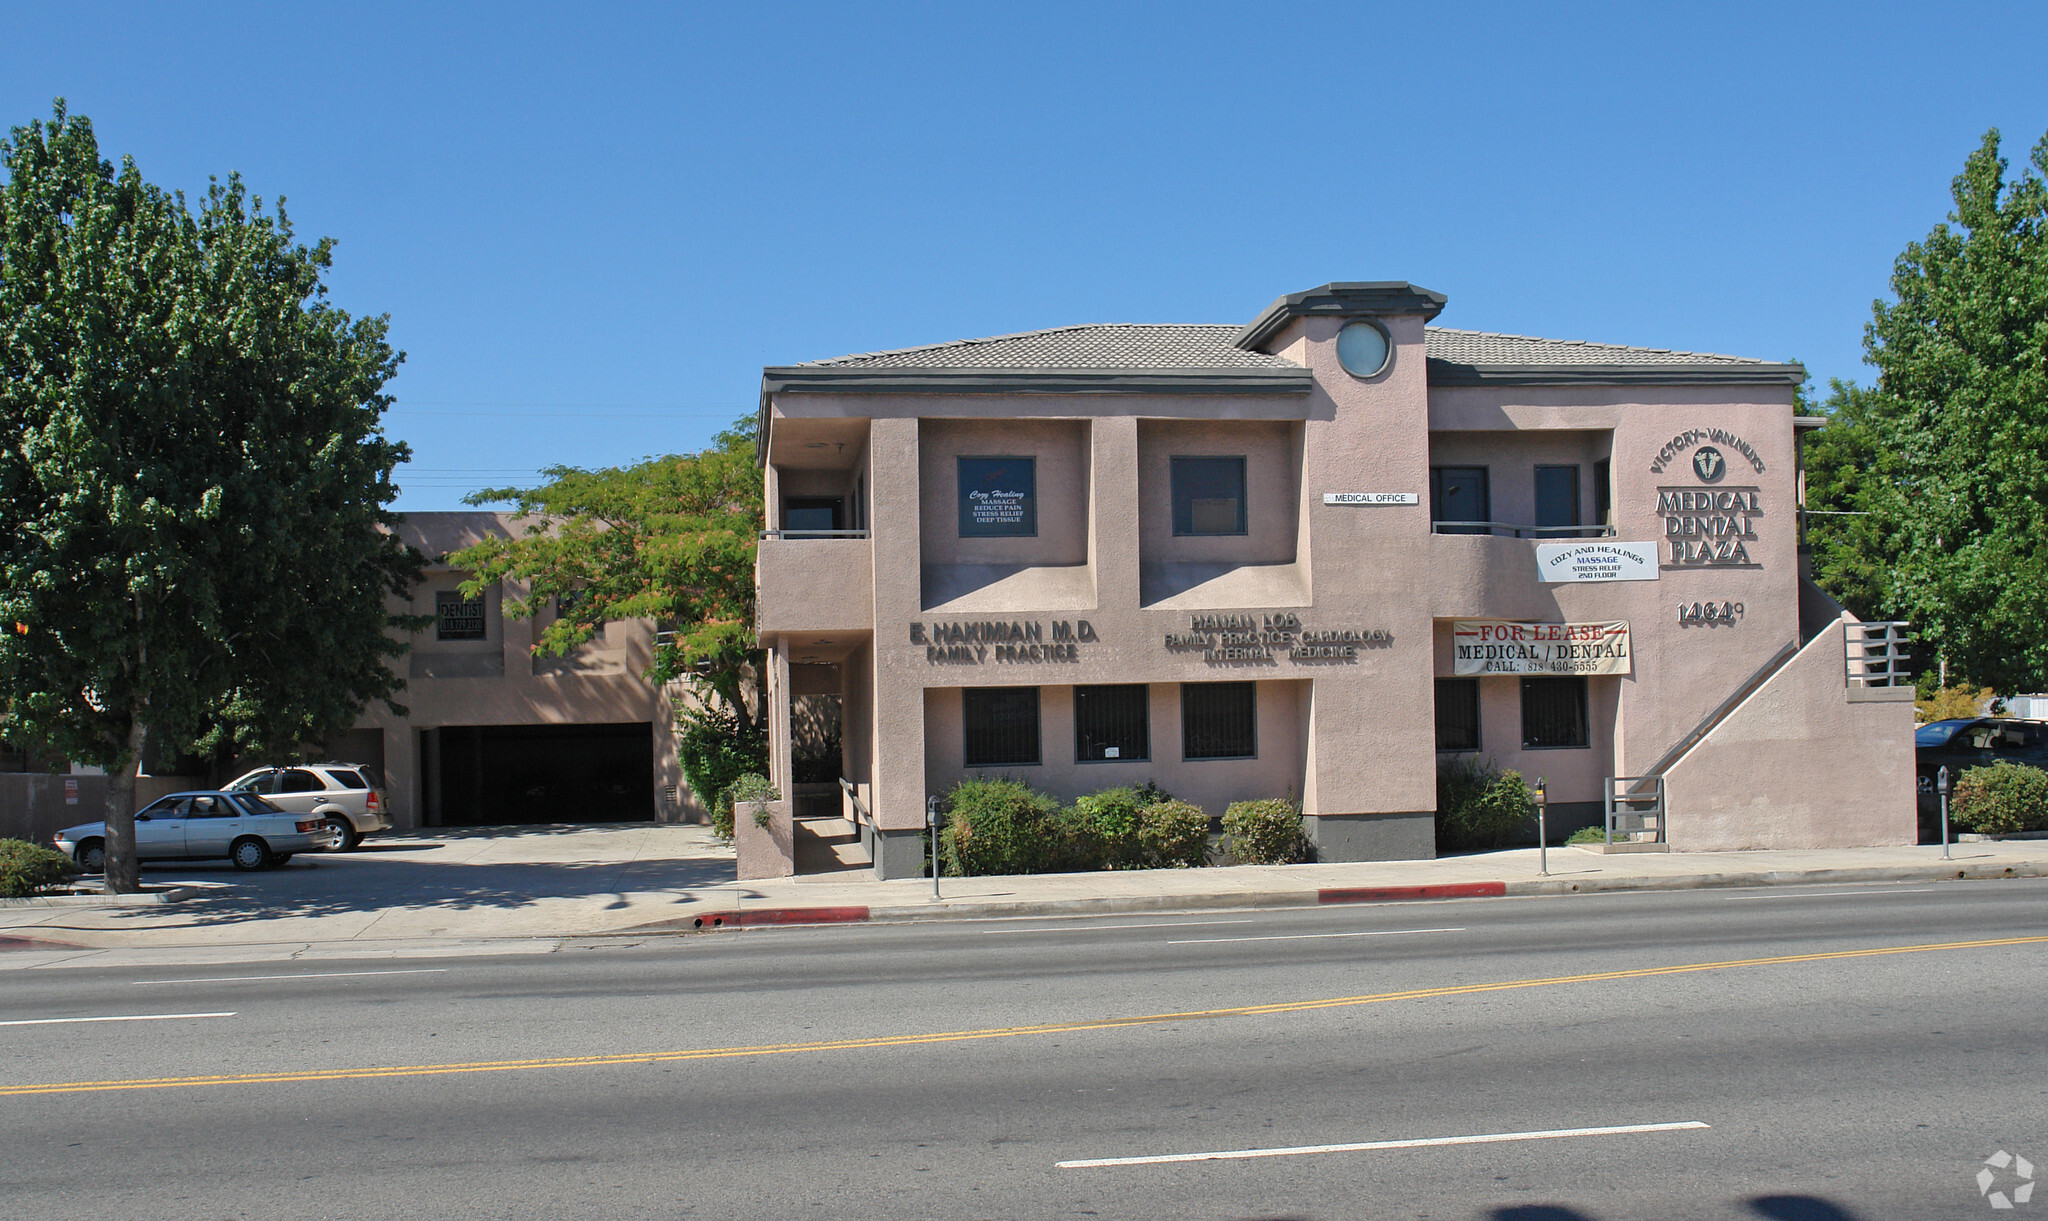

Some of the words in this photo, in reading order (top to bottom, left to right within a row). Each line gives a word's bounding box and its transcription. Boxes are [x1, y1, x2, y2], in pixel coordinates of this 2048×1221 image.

[969, 490, 989, 500] Cozy
[992, 490, 1024, 499] Healing
[1335, 494, 1372, 502] MEDICAL
[1376, 494, 1406, 502] OFFICE
[1655, 492, 1760, 513] MEDICAL
[1664, 516, 1756, 537] DENTAL
[1550, 550, 1573, 567] COZY
[1574, 546, 1595, 556] AND
[1597, 546, 1645, 565] HEALINGS
[1670, 540, 1749, 561] PLAZA
[1572, 565, 1598, 573] STRESS
[1599, 564, 1623, 572] RELIEF
[1576, 556, 1619, 564] MASSAGE
[1677, 601, 1744, 622] 14649
[1190, 613, 1255, 632] HANAN
[1262, 612, 1300, 630] LOB
[909, 621, 930, 643] E.
[933, 621, 1043, 642] HAKIMIAN
[1164, 633, 1211, 646] FAMILY
[1219, 631, 1292, 645] PRACTICE
[1301, 629, 1391, 643] CARDIOLOGY
[1480, 625, 1526, 641] FOR
[1533, 625, 1605, 641] LEASE
[926, 645, 988, 664] FAMILY
[995, 643, 1079, 663] PRACTICE
[1203, 647, 1272, 661] INTERNAL
[1287, 645, 1355, 659] MEDICINE
[1458, 645, 1540, 660] MEDICAL
[1556, 643, 1627, 659] DENTAL
[1486, 661, 1520, 672] CALL:
[1550, 661, 1598, 672] 430-5555
